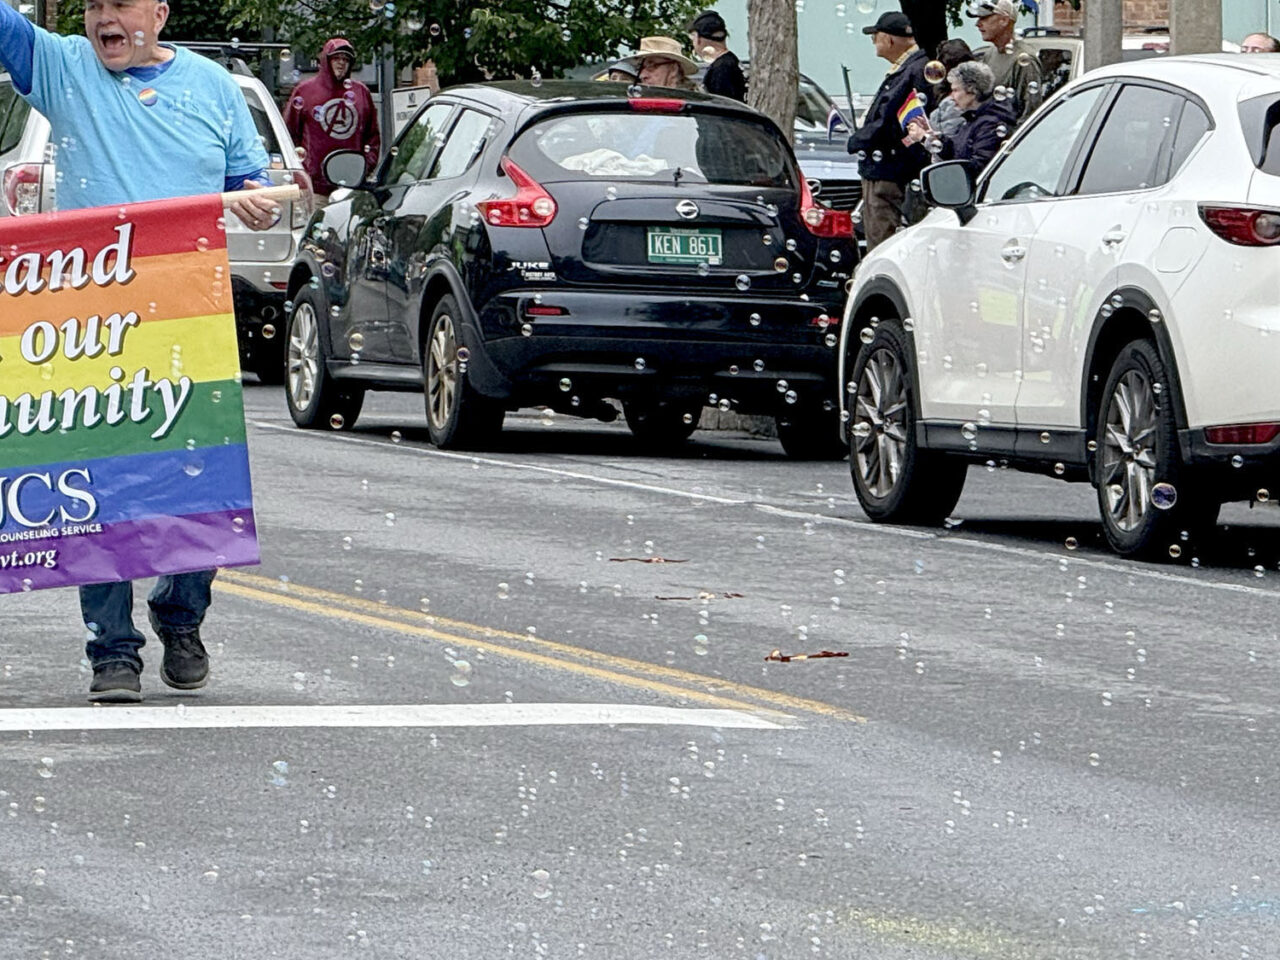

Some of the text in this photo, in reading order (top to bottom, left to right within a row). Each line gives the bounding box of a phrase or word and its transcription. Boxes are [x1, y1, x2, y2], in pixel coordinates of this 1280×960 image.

[654, 235, 716, 255] KEN 861
[506, 261, 550, 271] JUKE
[20, 311, 141, 366] our
[61, 523, 102, 536] SERVICE
